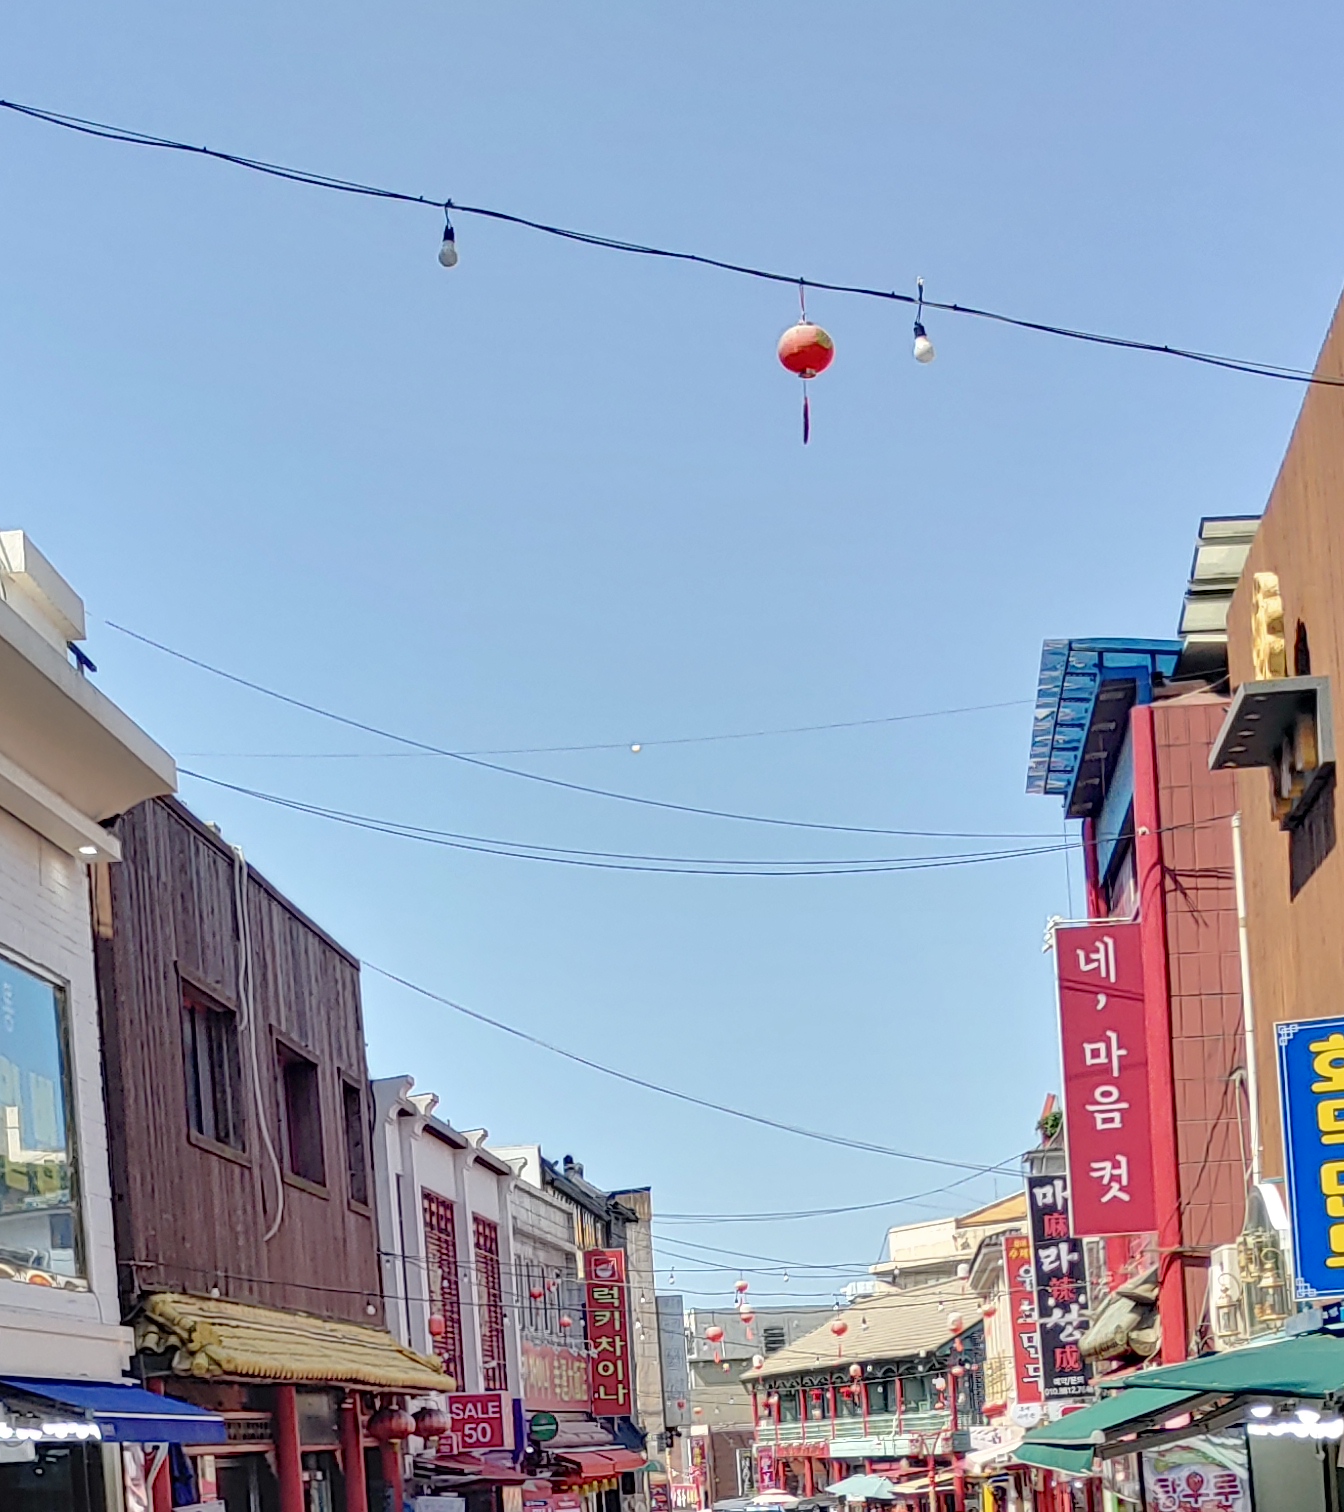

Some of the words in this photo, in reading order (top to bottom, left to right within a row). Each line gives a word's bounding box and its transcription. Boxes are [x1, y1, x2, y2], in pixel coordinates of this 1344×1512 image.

[1082, 1029, 1131, 1131] 마음
[1089, 1155, 1131, 1204] 컷
[591, 1285, 630, 1406] 럭키차이나
[450, 1401, 501, 1420] SALE
[463, 1423, 492, 1443] 50
